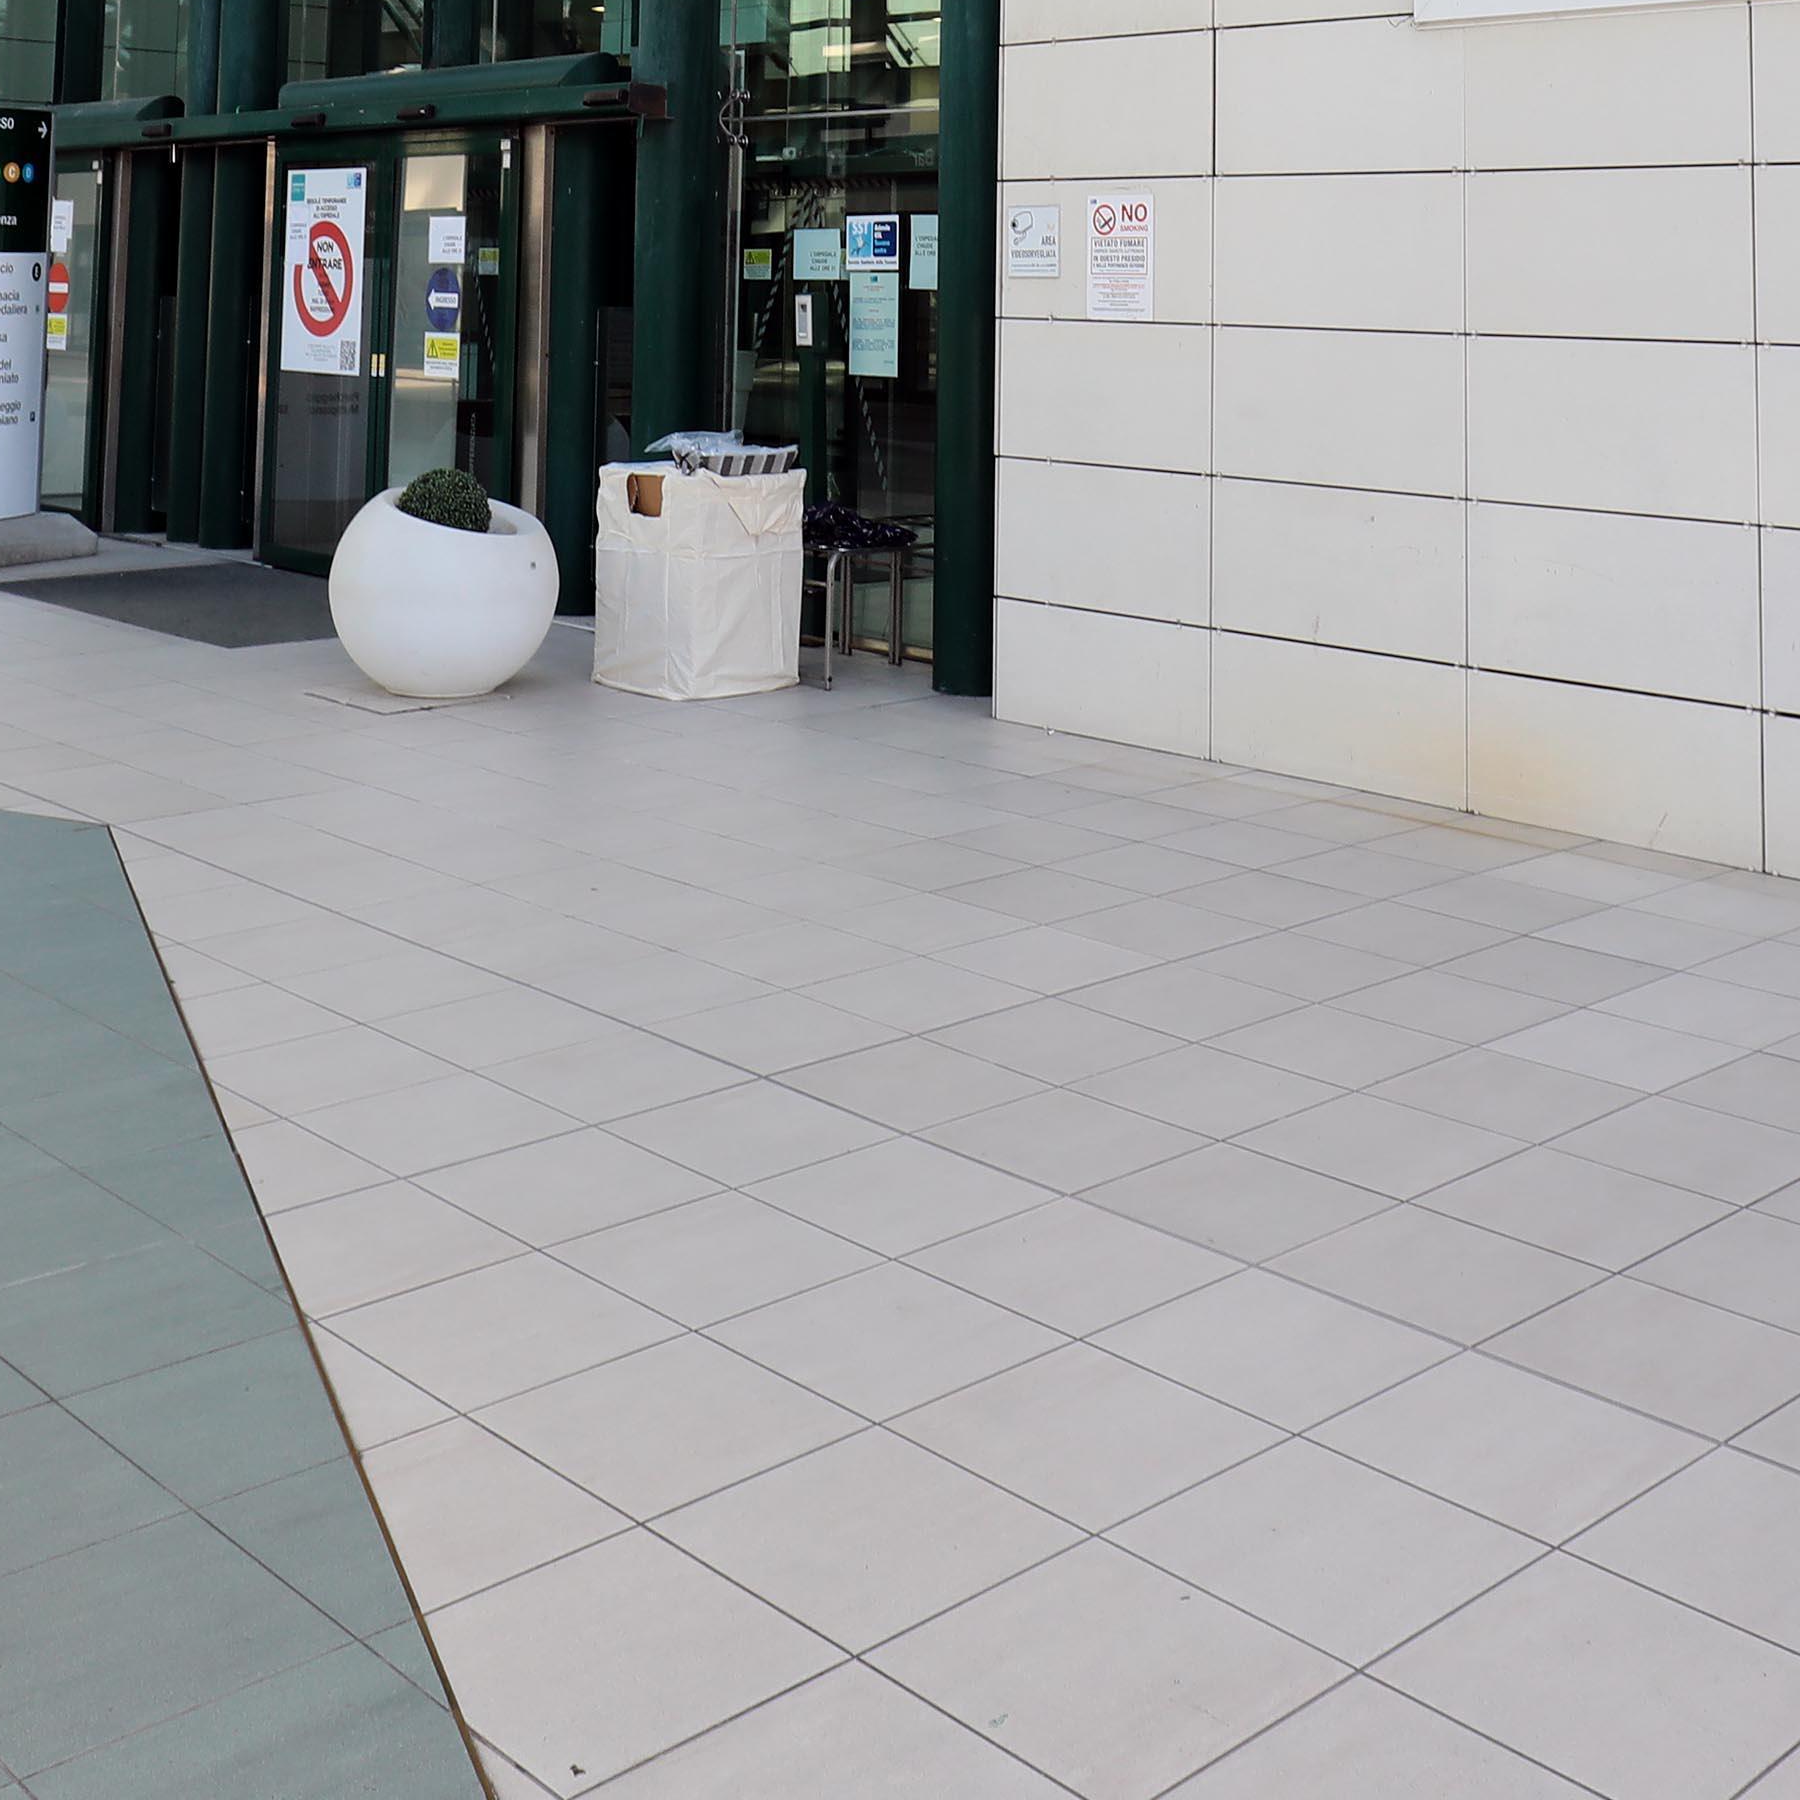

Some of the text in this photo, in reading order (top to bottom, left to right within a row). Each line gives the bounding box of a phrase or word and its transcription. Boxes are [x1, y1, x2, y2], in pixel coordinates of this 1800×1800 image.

[8, 165, 16, 178] C
[26, 166, 32, 178] D
[1121, 203, 1148, 222] NO
[852, 222, 869, 236] SST
[1120, 224, 1148, 232] SMOKING
[1041, 235, 1056, 246] AREA
[1094, 239, 1145, 247] VIETATO FUMARE
[316, 241, 334, 252] NON
